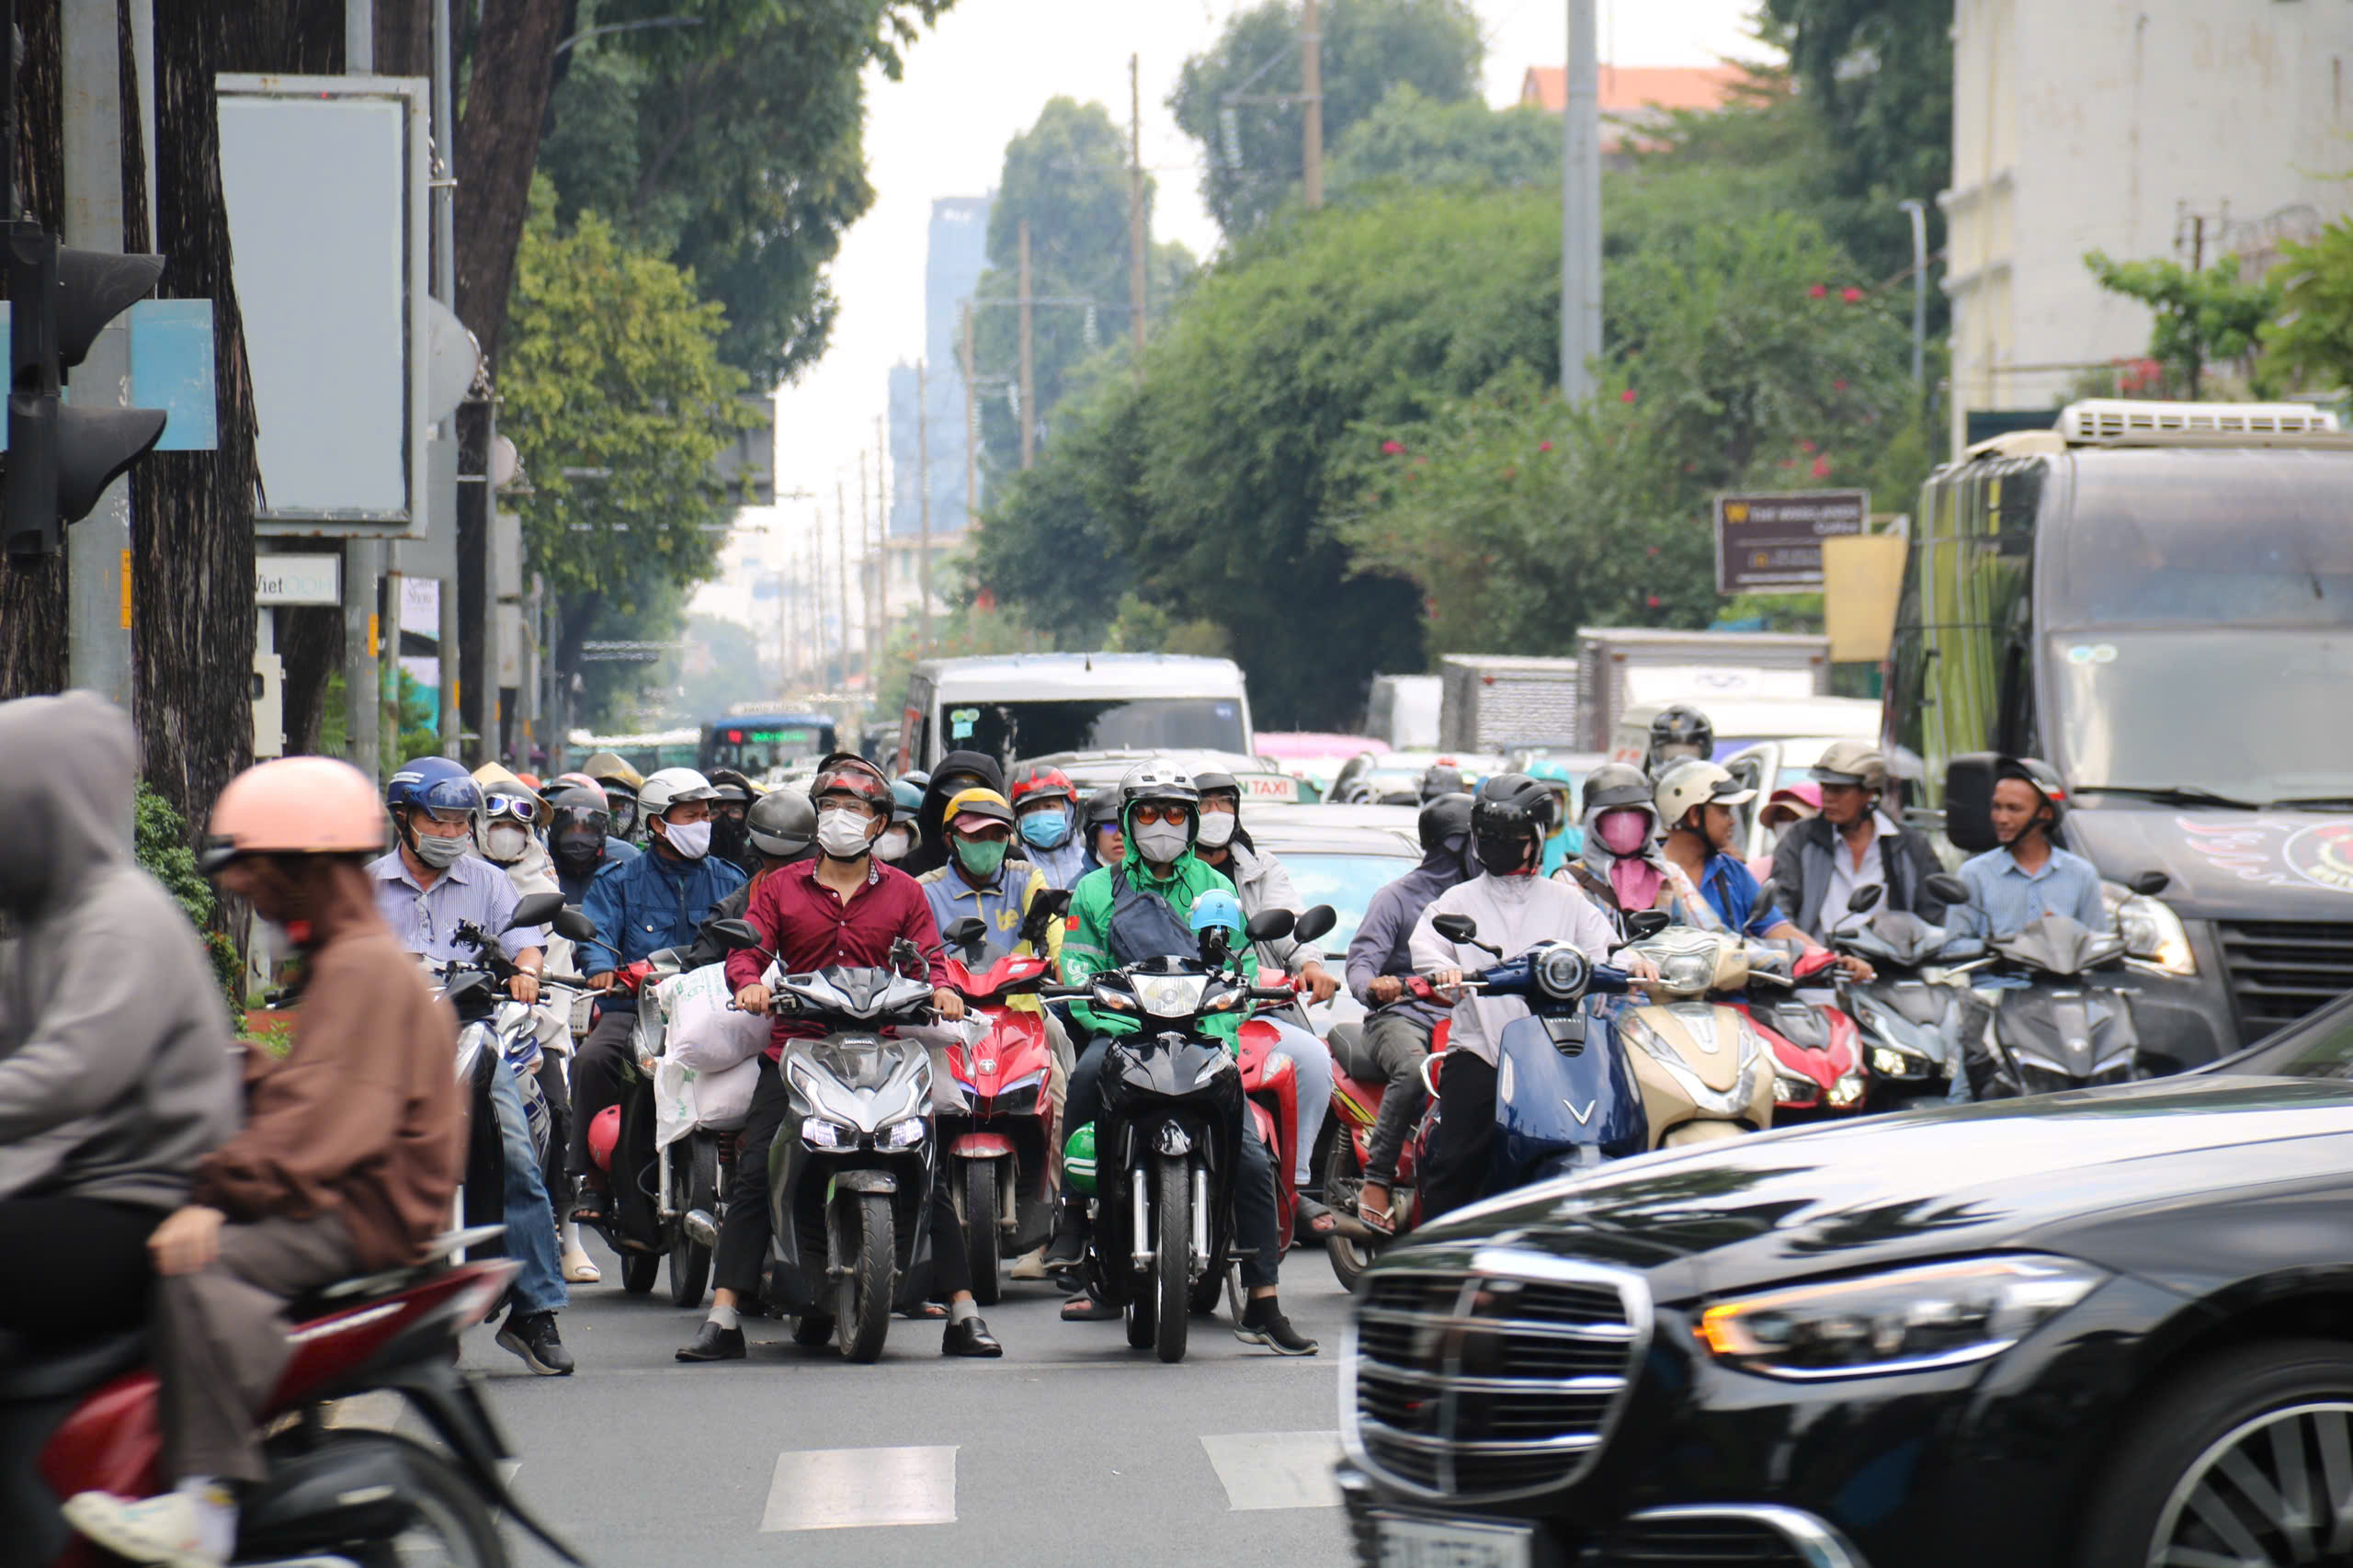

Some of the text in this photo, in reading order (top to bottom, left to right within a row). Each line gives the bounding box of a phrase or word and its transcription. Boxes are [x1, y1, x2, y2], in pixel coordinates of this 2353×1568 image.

[1253, 780, 1288, 795] TAXI
[995, 908, 1019, 932] be
[1156, 1030, 1188, 1040] HONDA
